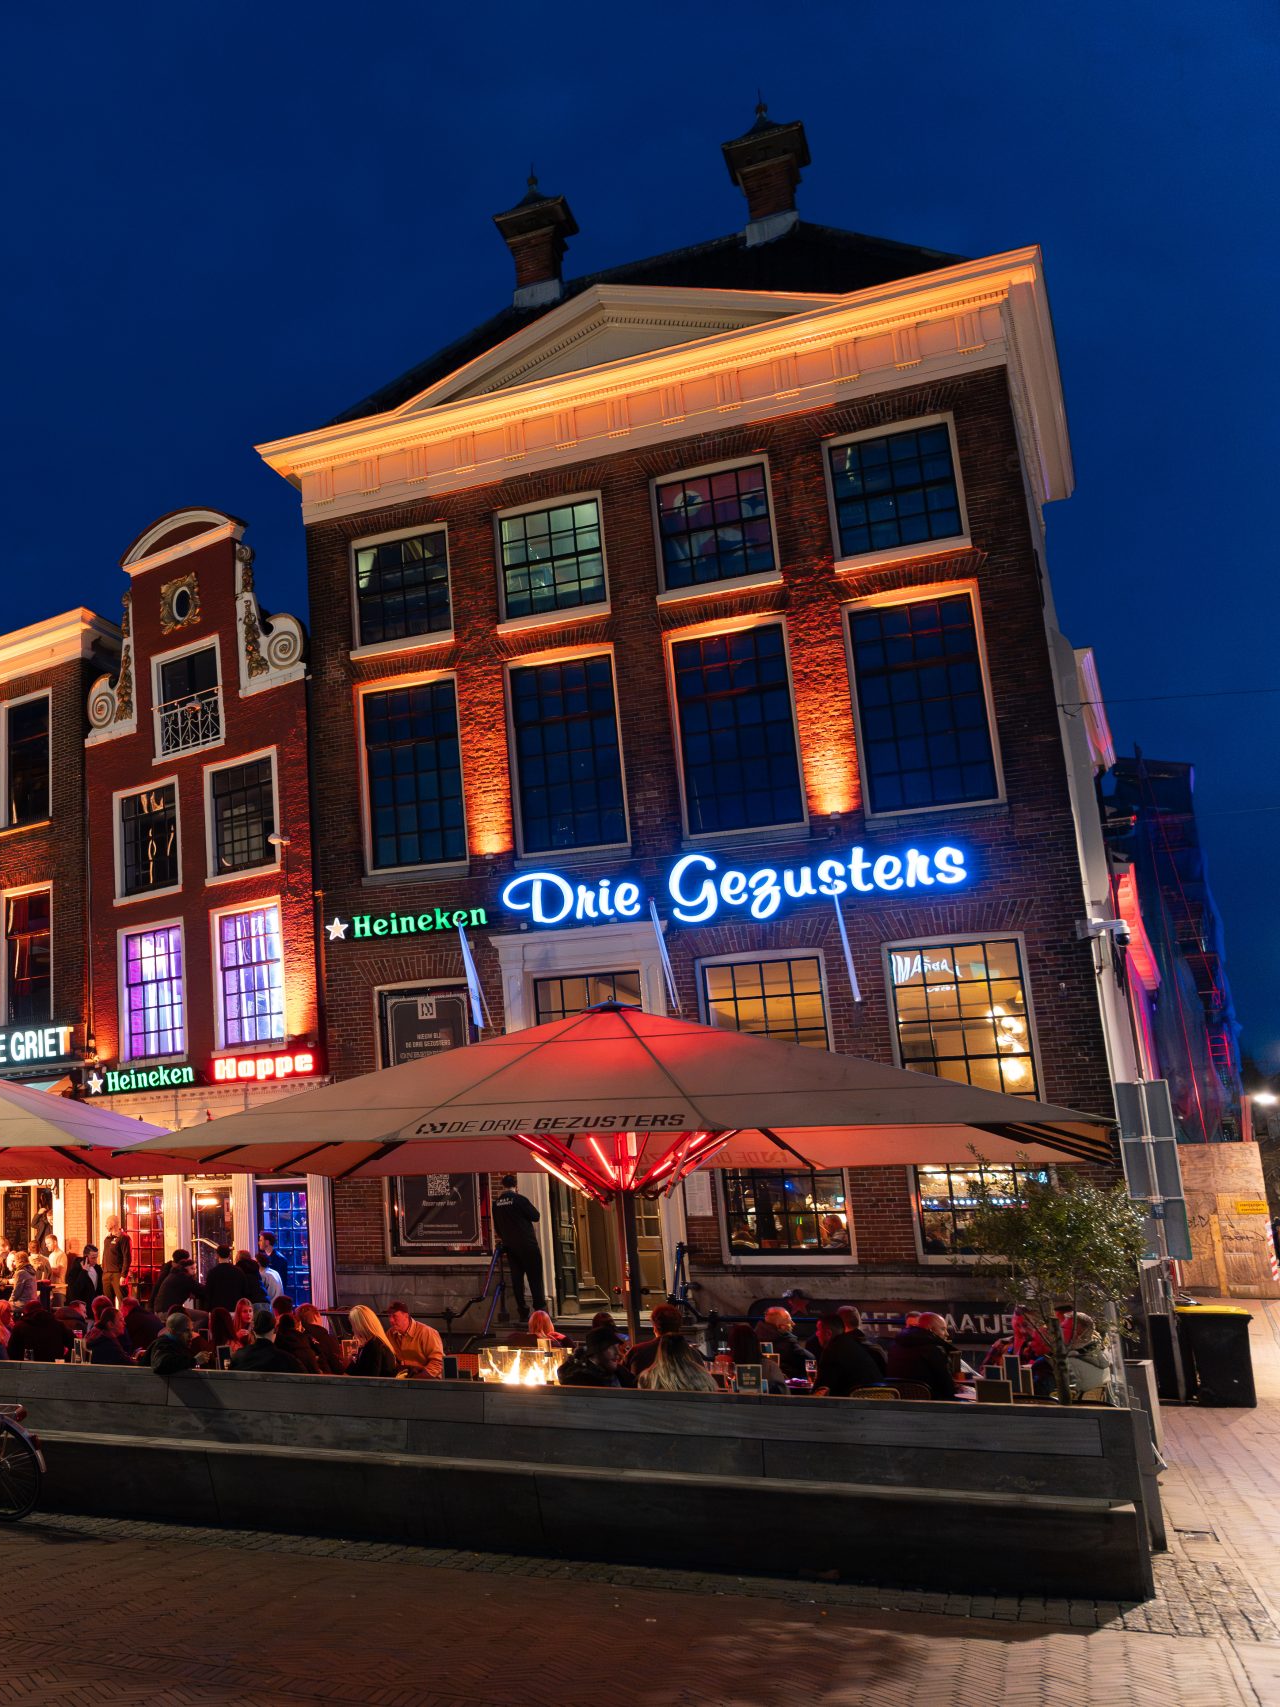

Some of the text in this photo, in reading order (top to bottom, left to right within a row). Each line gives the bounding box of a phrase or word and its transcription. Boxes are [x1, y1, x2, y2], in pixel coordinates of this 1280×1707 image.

[503, 846, 968, 924] Drie Gezusters
[353, 907, 488, 938] Heineken
[10, 1026, 74, 1061] GRIET
[106, 1065, 194, 1092] Heineken
[214, 1053, 314, 1081] Hoppe
[447, 1114, 686, 1133] DE DRIE GEZUSTERS
[859, 1312, 901, 1332] AFE
